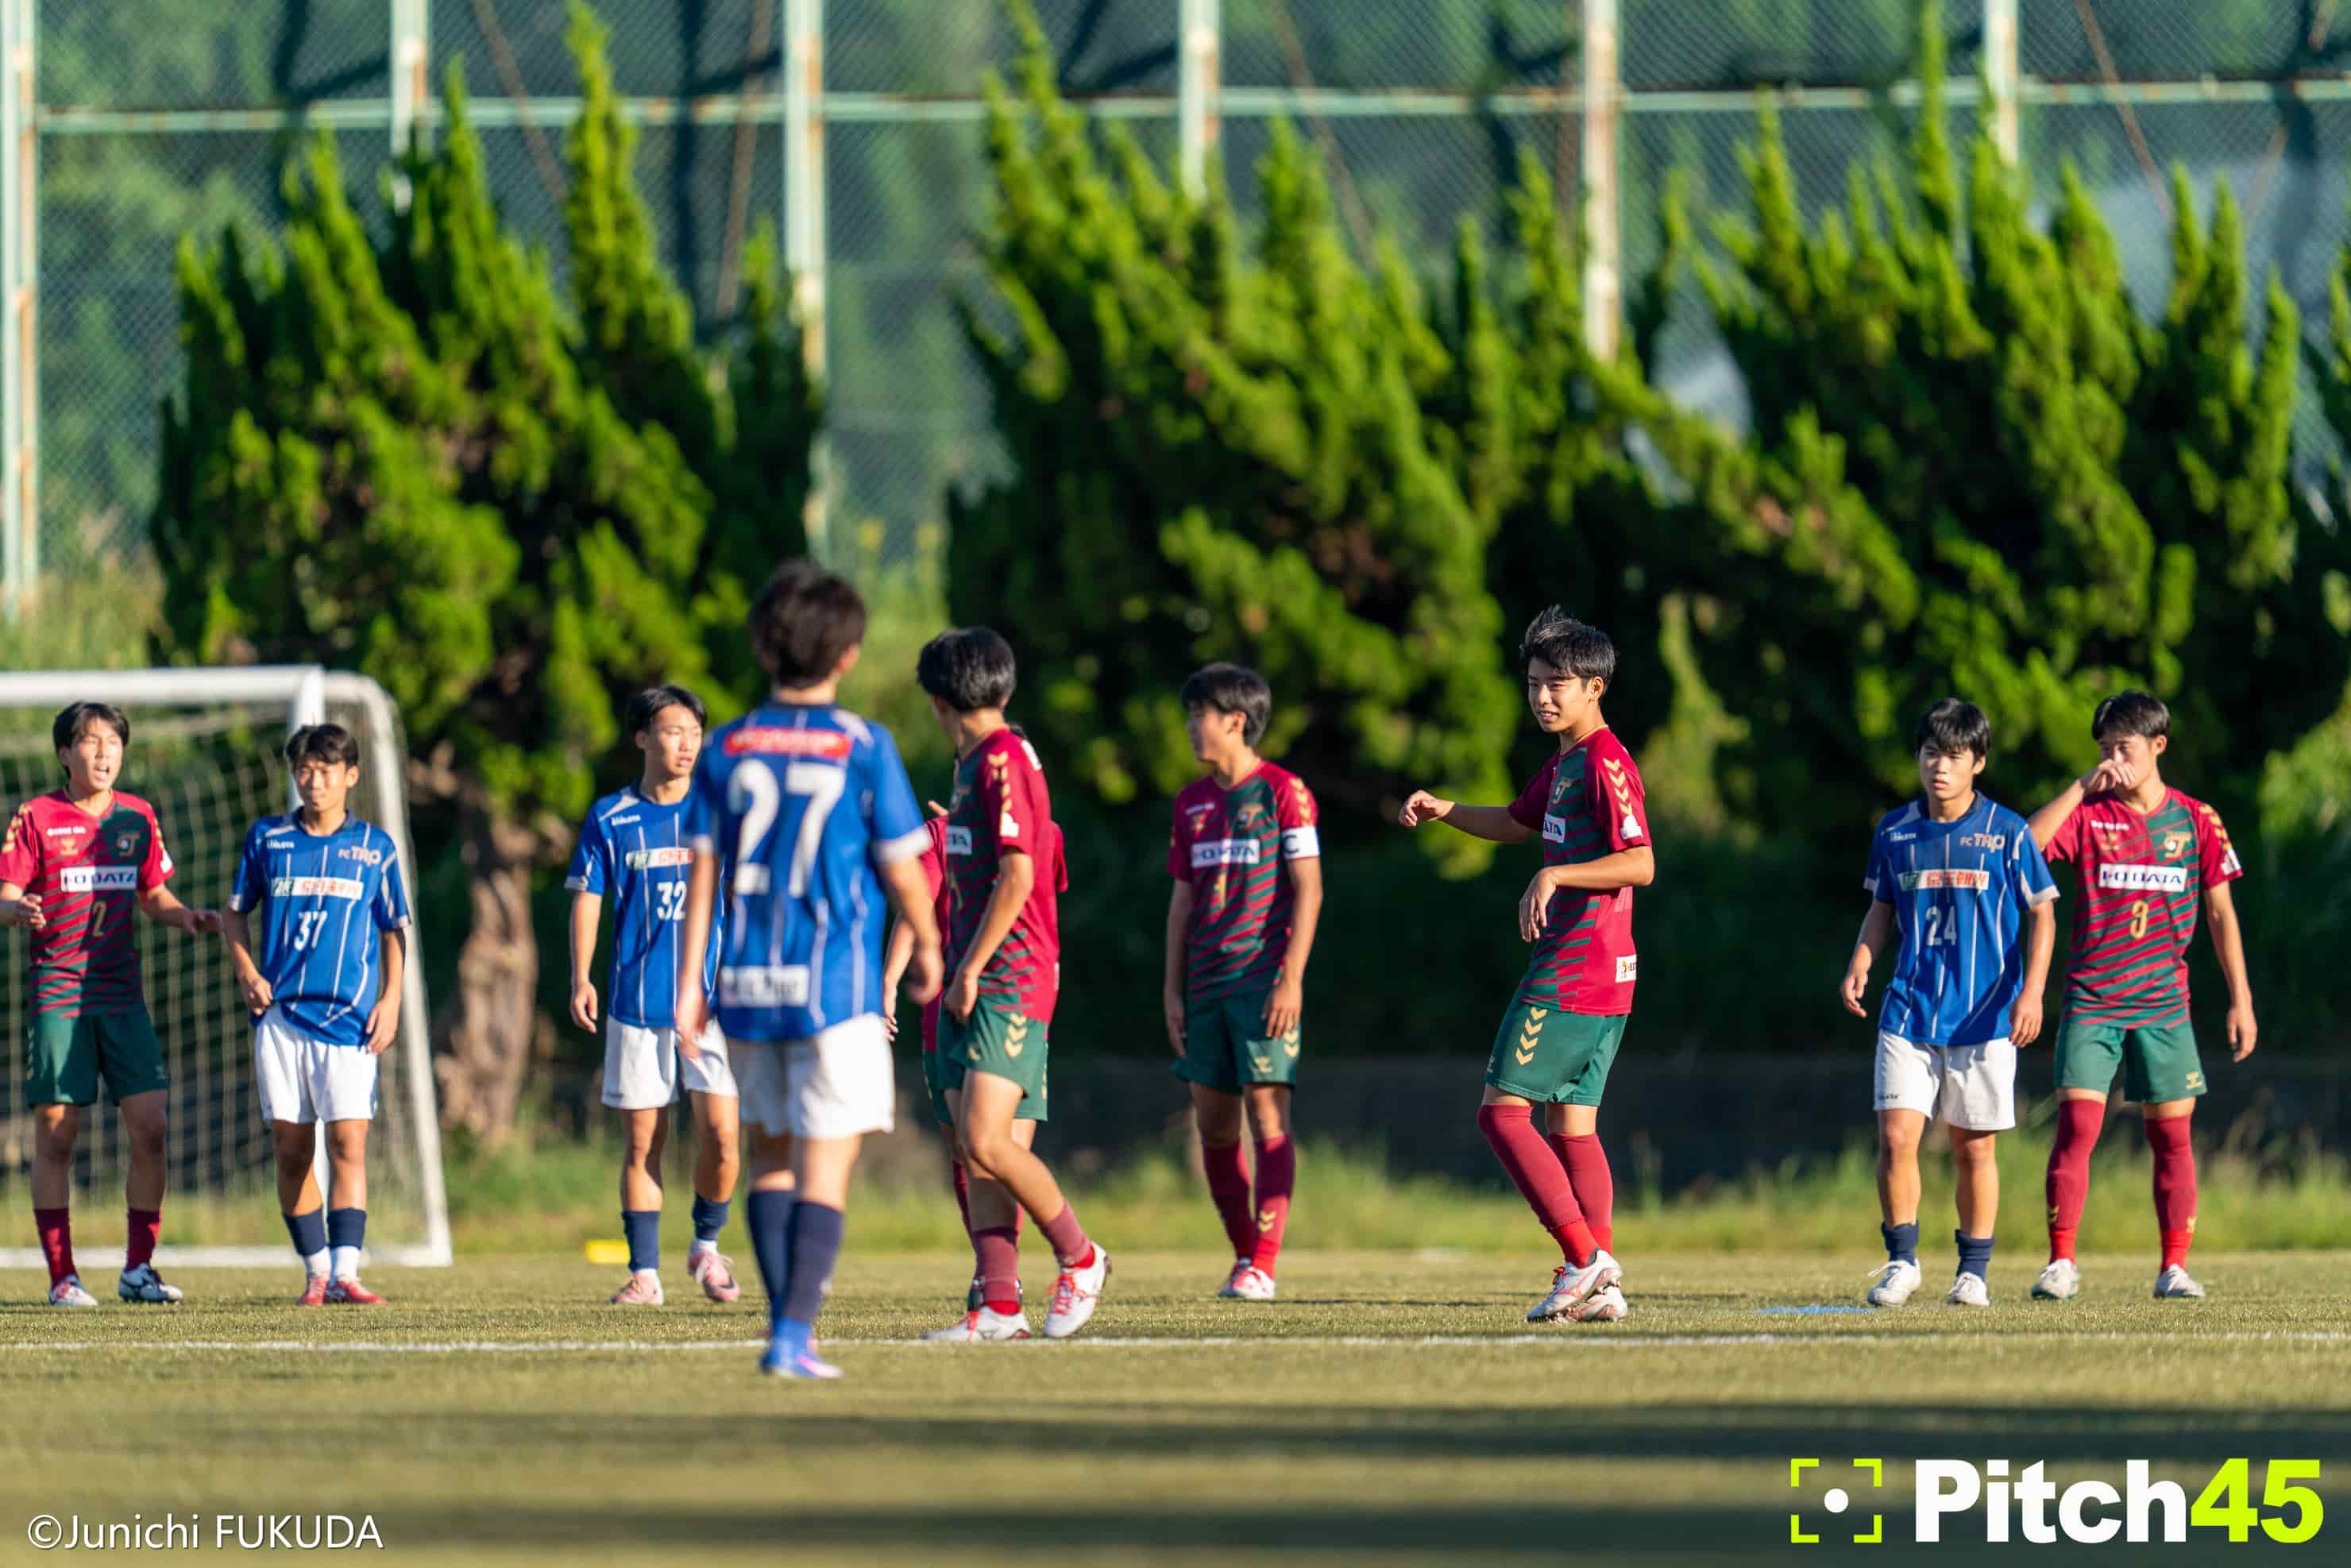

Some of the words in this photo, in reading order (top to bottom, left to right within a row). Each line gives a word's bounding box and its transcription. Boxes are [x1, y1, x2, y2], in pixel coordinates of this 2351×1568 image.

[728, 757, 847, 898] 27
[92, 900, 107, 937] 2
[657, 880, 687, 921] 32
[2129, 899, 2149, 940] 3
[293, 910, 328, 951] 37
[1924, 905, 1957, 946] 24
